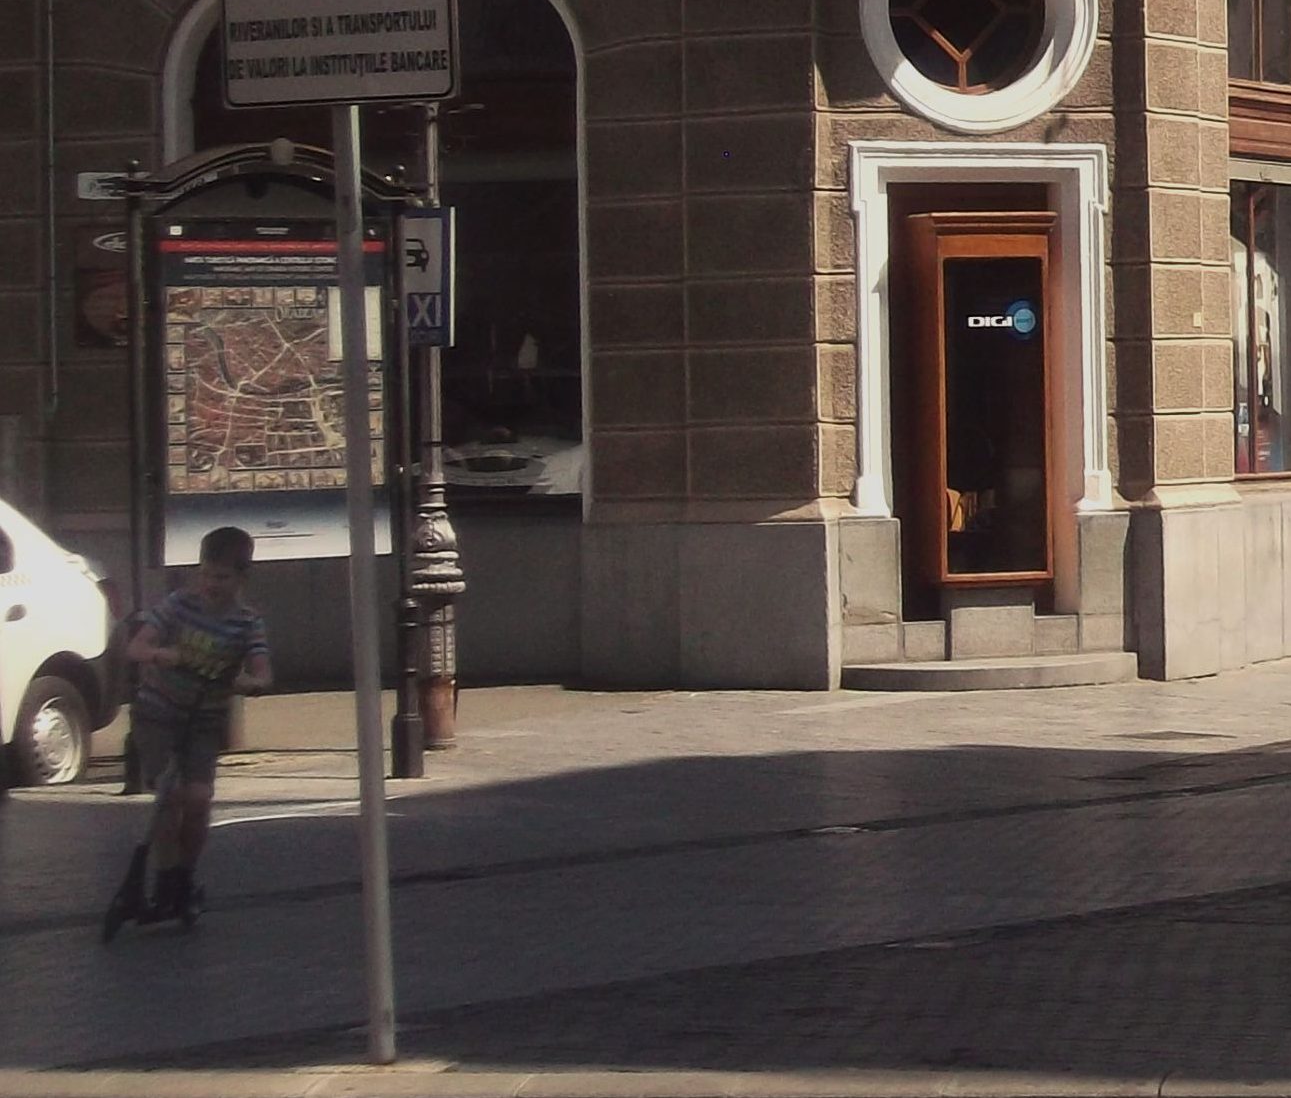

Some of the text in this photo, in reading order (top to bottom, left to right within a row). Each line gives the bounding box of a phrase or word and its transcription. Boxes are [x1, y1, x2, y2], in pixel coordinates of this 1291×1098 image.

[230, 17, 308, 42] RIVERANILOR
[325, 15, 334, 35] A
[337, 9, 437, 36] TRANSPORTULUI
[228, 59, 244, 80] DE
[245, 57, 289, 78] VALORI
[292, 56, 307, 77] LA
[391, 49, 448, 73] BANCARE
[967, 316, 1013, 327] DIGI
